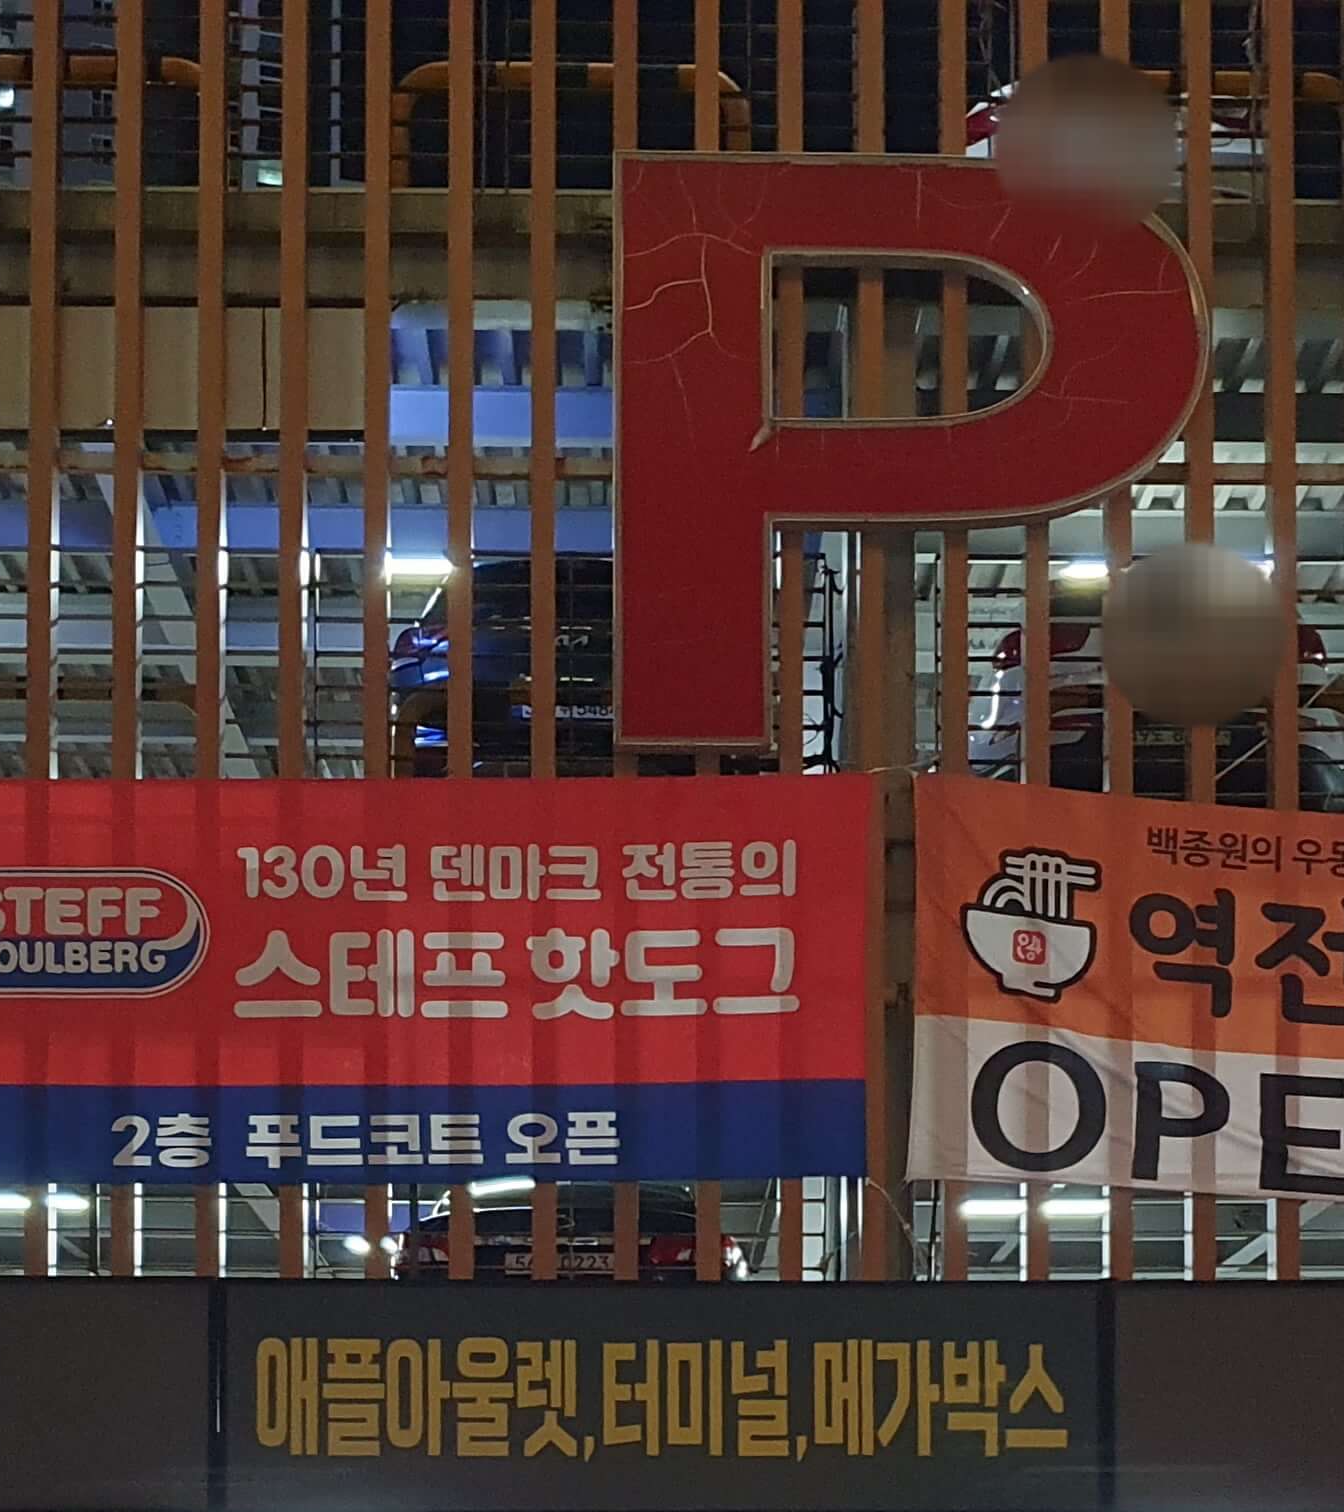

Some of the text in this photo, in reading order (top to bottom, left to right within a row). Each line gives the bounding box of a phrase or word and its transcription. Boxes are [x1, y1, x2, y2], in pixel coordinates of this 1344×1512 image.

[613, 150, 1210, 752] P
[237, 839, 797, 902] 130년 덴마크 전통의
[1146, 826, 1283, 873] 백종원의
[233, 927, 801, 1020] 스테프 핫도그
[110, 1110, 620, 1169] 2층 푸드코트 오픈
